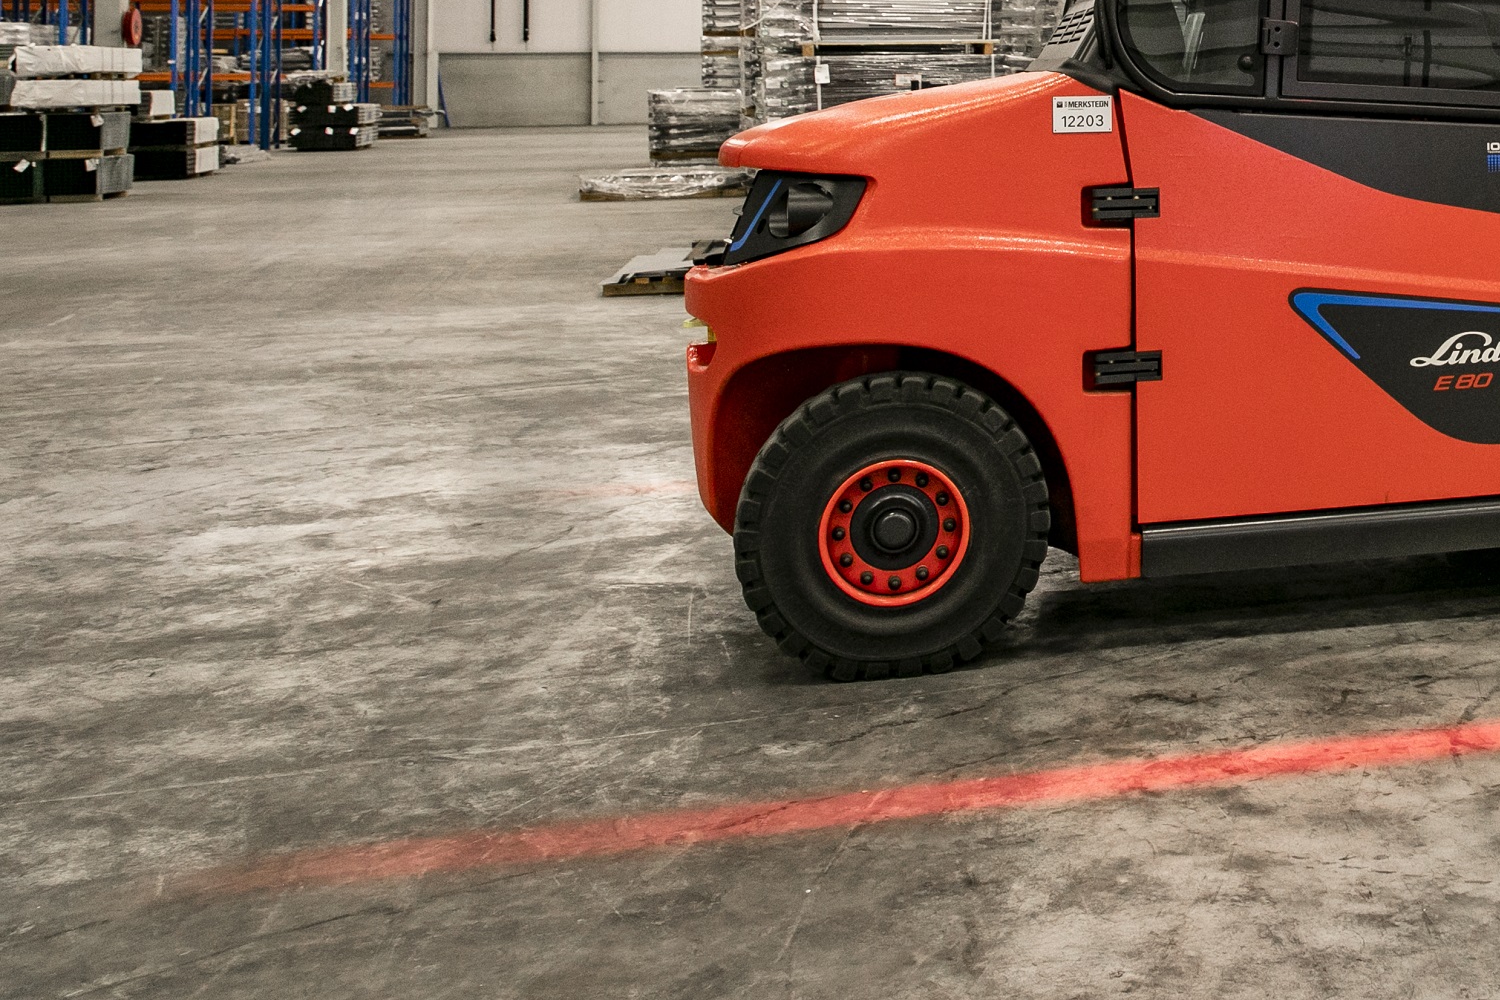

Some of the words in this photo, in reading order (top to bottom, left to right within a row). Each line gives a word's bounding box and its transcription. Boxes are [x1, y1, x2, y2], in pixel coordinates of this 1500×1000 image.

[1061, 114, 1104, 128] 12203
[1433, 375, 1455, 391] E
[1454, 372, 1494, 389] 80
